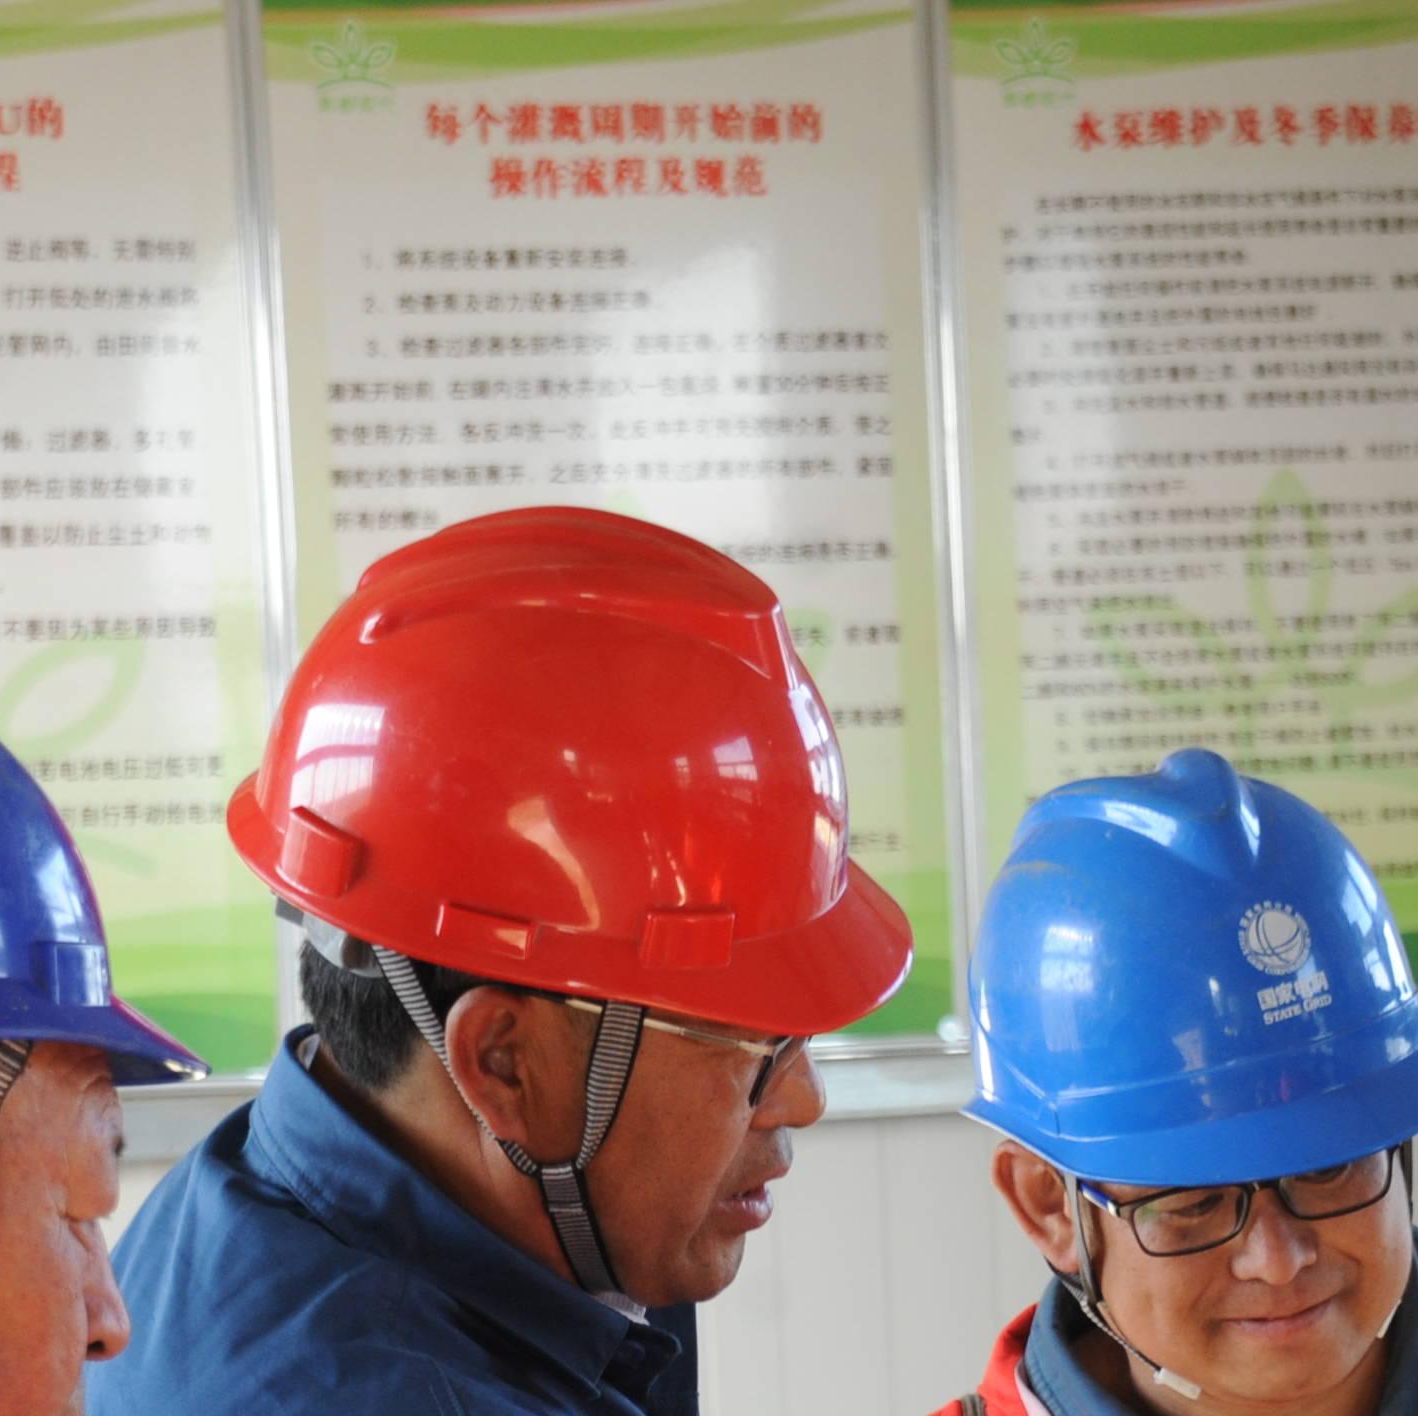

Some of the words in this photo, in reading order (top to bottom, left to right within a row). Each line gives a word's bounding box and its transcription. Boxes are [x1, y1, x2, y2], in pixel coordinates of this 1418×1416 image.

[424, 102, 823, 144] 每个灌溉周期开始前的
[490, 156, 768, 200] 操作流程及规范
[1257, 970, 1330, 1011] 国家电网
